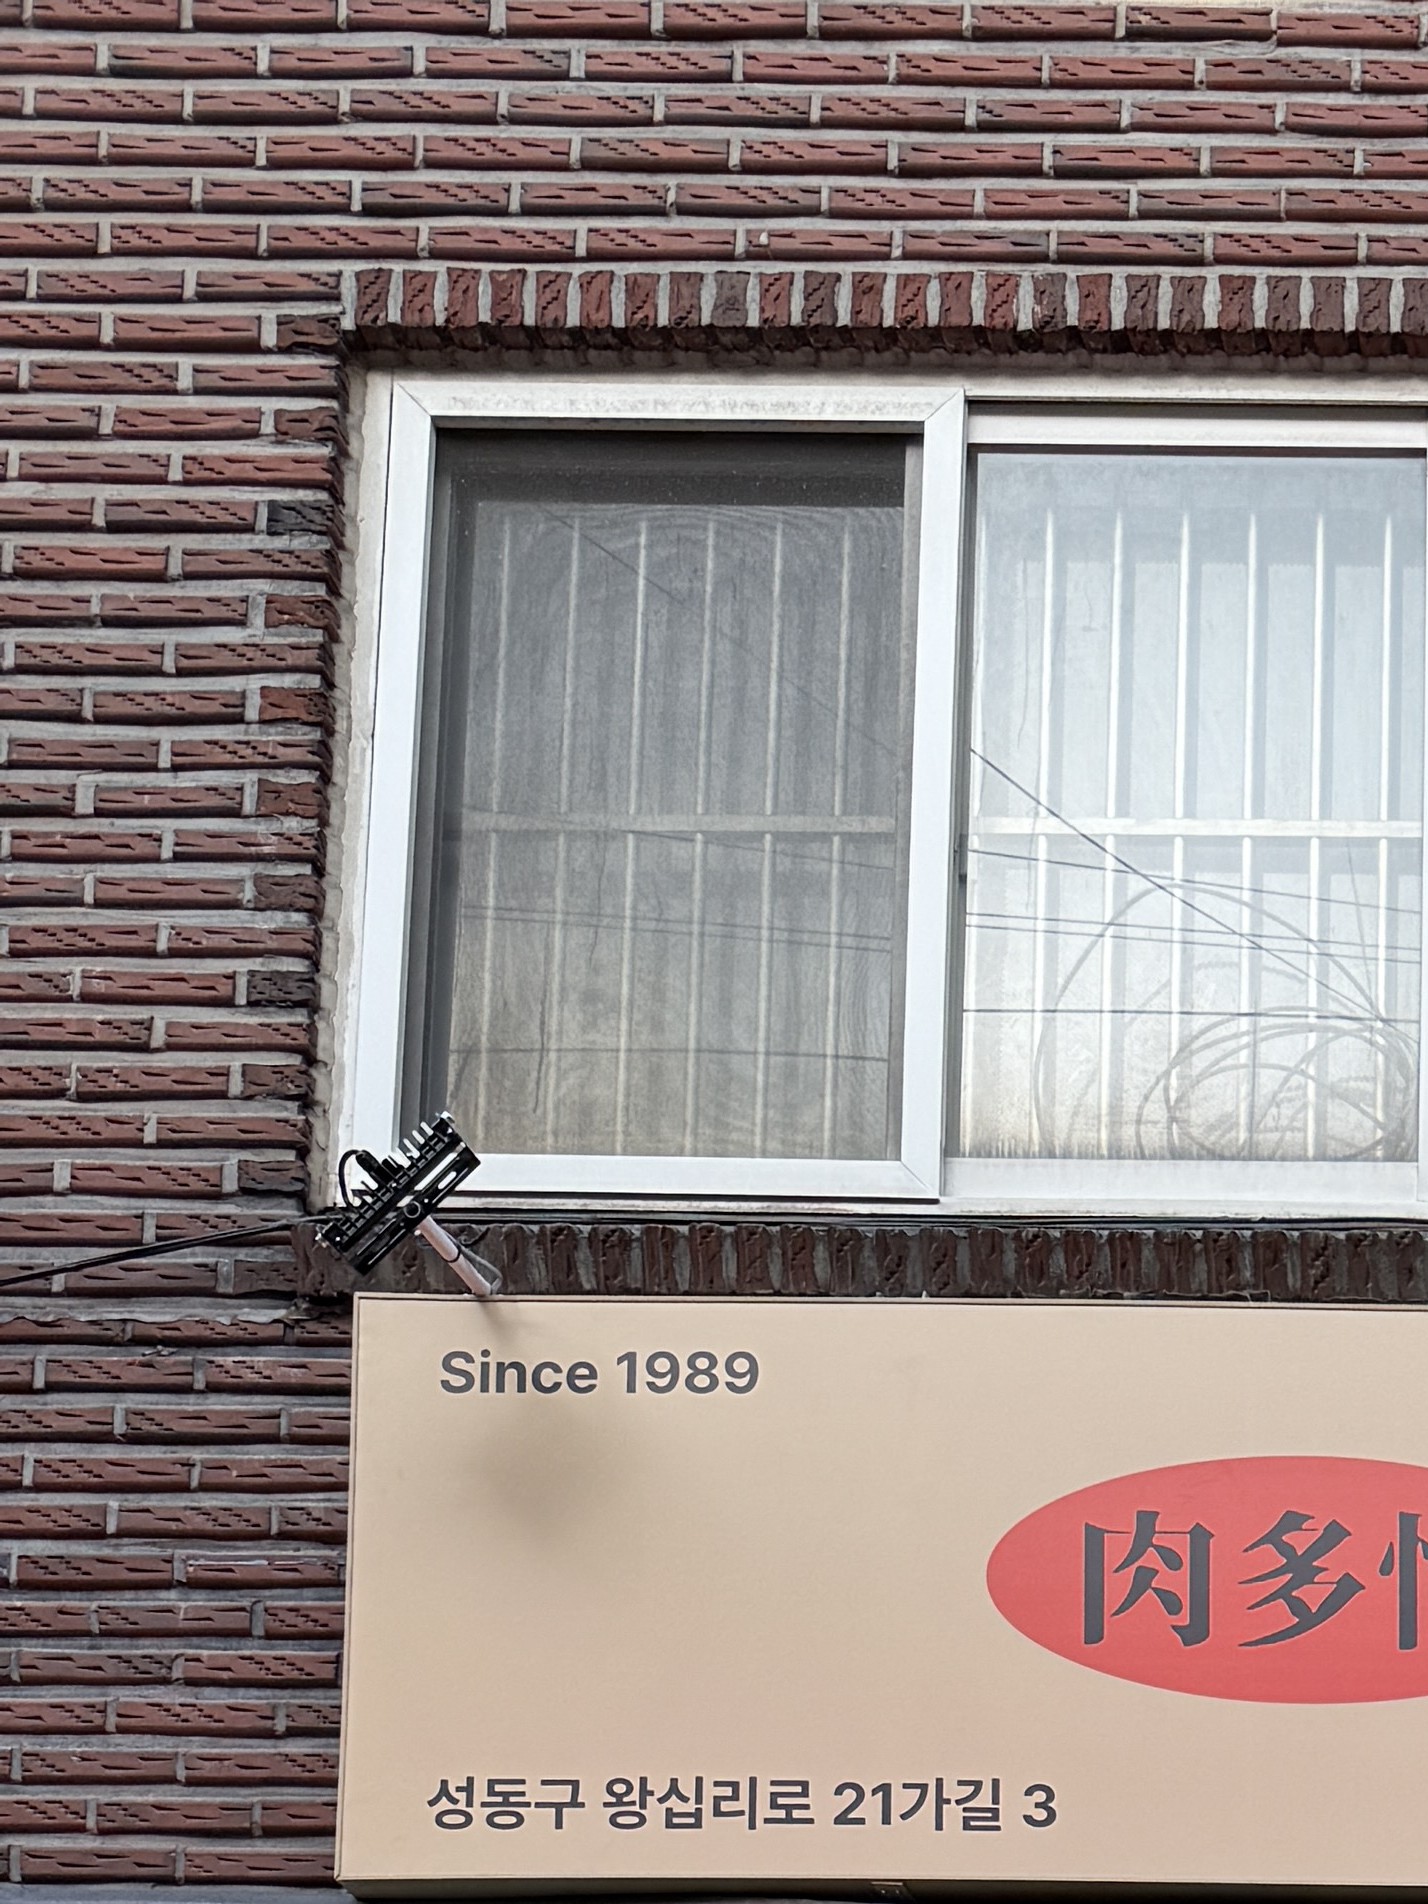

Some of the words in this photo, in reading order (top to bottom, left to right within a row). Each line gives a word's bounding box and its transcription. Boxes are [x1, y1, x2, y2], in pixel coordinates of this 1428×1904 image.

[441, 1349, 597, 1394] Since
[617, 1352, 758, 1393] 1989
[427, 1776, 585, 1830] 성동구
[603, 1776, 814, 1830] 왕십리로
[834, 1778, 1001, 1831] 21가길
[1023, 1784, 1056, 1827] 3
